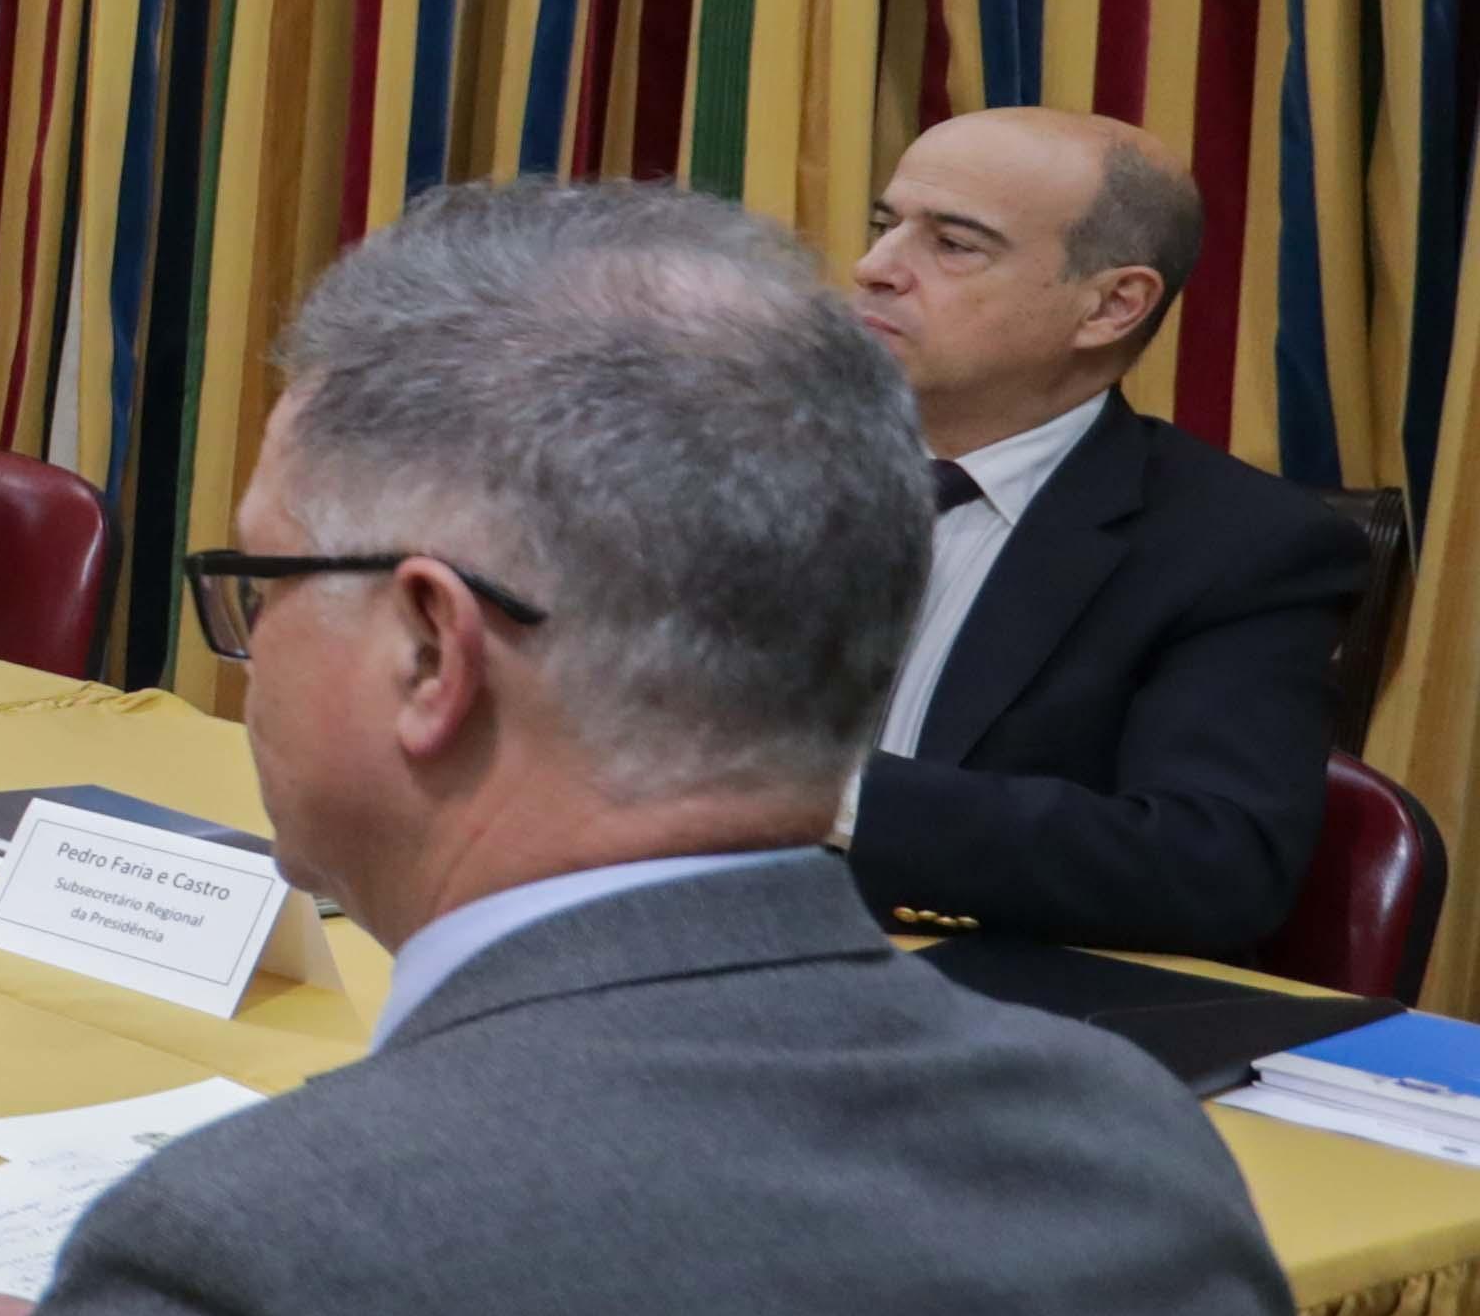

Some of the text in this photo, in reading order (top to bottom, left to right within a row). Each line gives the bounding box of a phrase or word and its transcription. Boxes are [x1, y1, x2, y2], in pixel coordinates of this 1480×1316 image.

[57, 841, 230, 901] Pedro Faria e Castro
[55, 876, 205, 927] Subsecretário Regional
[71, 907, 164, 943] da Presidência
